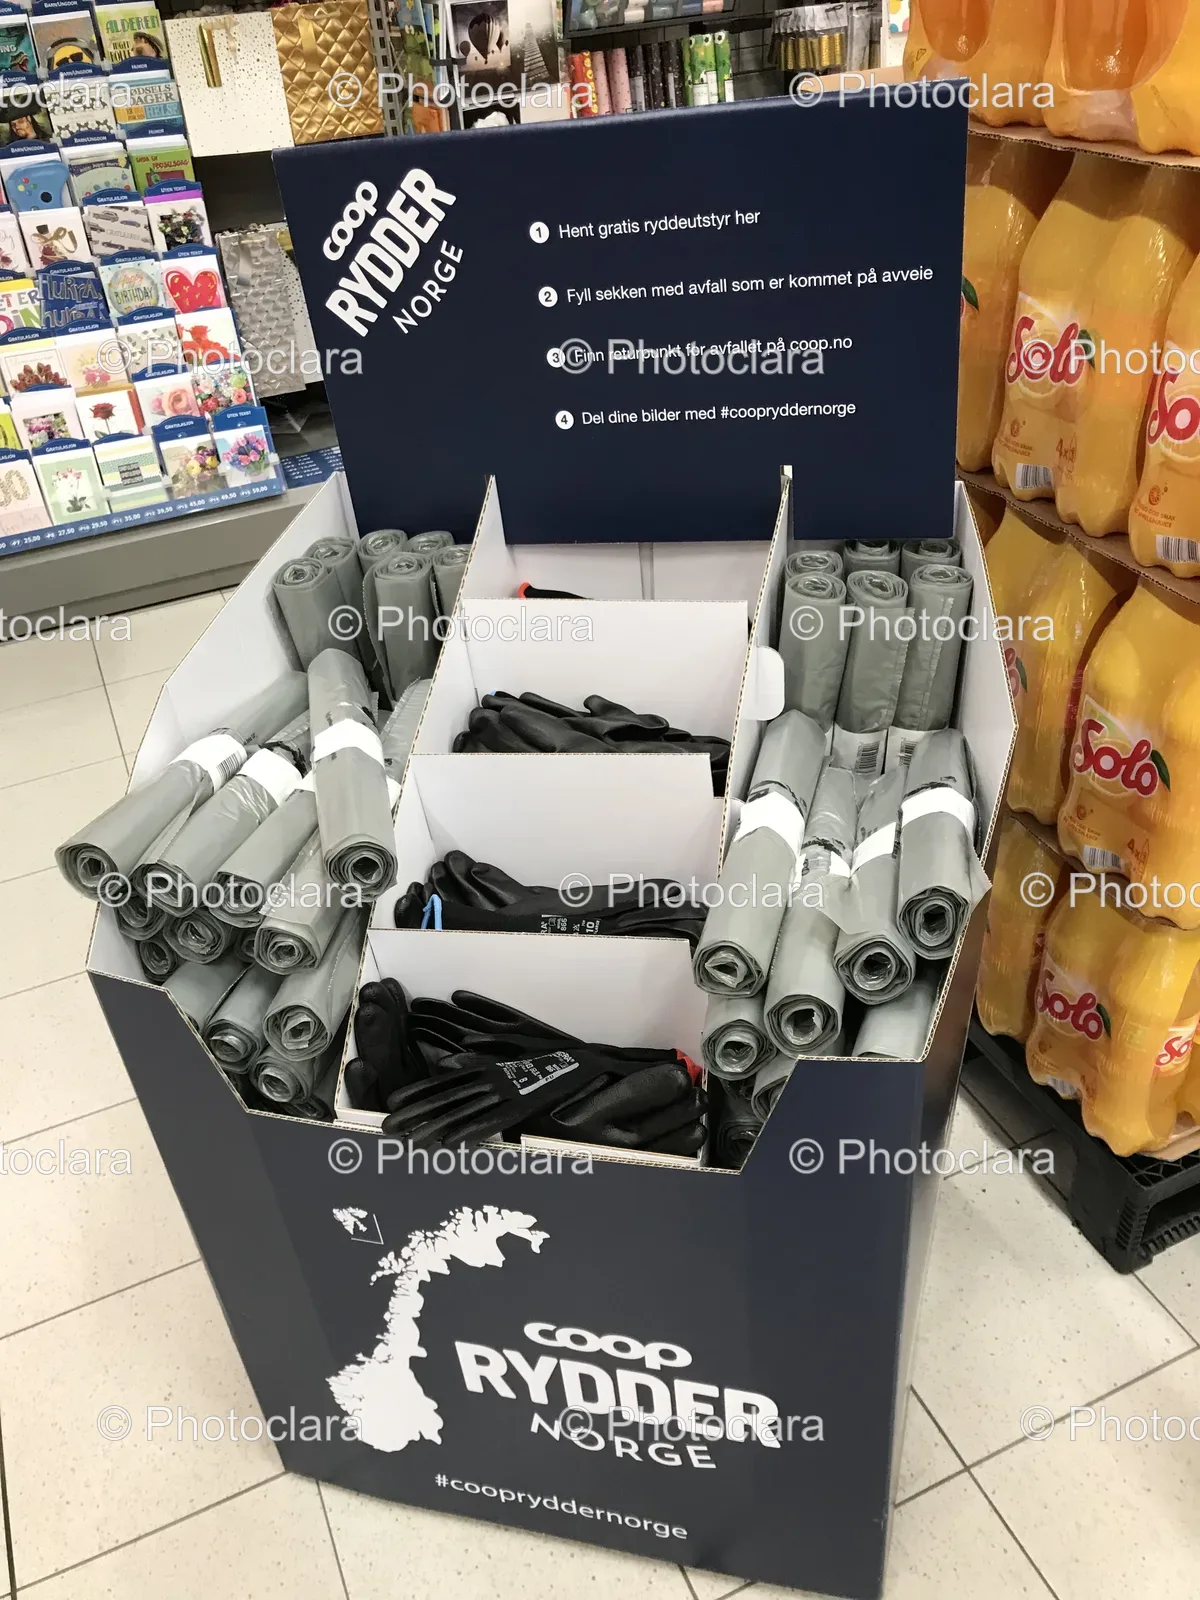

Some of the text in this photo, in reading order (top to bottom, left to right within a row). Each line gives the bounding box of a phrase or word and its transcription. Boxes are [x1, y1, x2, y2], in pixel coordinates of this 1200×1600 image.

[97, 195, 128, 203] GRATULASJON
[323, 181, 378, 261] coop
[558, 222, 594, 238] Hent
[598, 219, 640, 239] gratis
[644, 212, 731, 235] ryddeutstyr
[735, 210, 760, 224] her
[325, 168, 456, 337] RYDDER
[114, 286, 153, 304] BIRTHDAY
[392, 240, 463, 334] NORGE
[566, 288, 591, 305] Fyll
[596, 286, 647, 302] sekken
[651, 282, 684, 297] med
[688, 278, 727, 295] avfall
[732, 279, 764, 292] som
[769, 277, 784, 289] er
[789, 271, 852, 288] kommet
[857, 268, 878, 287] på
[882, 266, 934, 282] avveie
[8, 333, 40, 342] GRATULASJON
[68, 324, 100, 333] GRATULASJON
[574, 350, 604, 363] Finn
[610, 344, 682, 362] returpunkt
[685, 342, 706, 357] for
[710, 340, 762, 356] avfallet
[766, 337, 786, 355] på
[790, 337, 853, 354] coop.no
[1006, 315, 1085, 386] Solo
[145, 368, 175, 378] GRATULASJON
[164, 420, 194, 430] GRATULASJON
[582, 412, 604, 425] Del
[608, 410, 638, 424] dine
[642, 408, 681, 422] bilder
[684, 406, 716, 420] med
[720, 403, 856, 420] #coopryddernorge
[46, 443, 76, 452] GRATULASJON
[24, 535, 41, 544] 25,00
[92, 520, 108, 528] 29,50
[124, 514, 141, 522] 35,00
[157, 506, 174, 514] 39,50
[252, 486, 268, 494] 59,00
[1072, 718, 1158, 797] Solo
[586, 921, 595, 933] 10
[1037, 967, 1104, 1041] Solo
[524, 1322, 692, 1370] coop
[455, 1341, 781, 1448] RYDDER
[530, 1412, 717, 1469] NORGE
[435, 1474, 688, 1540] #coopryddernorge
